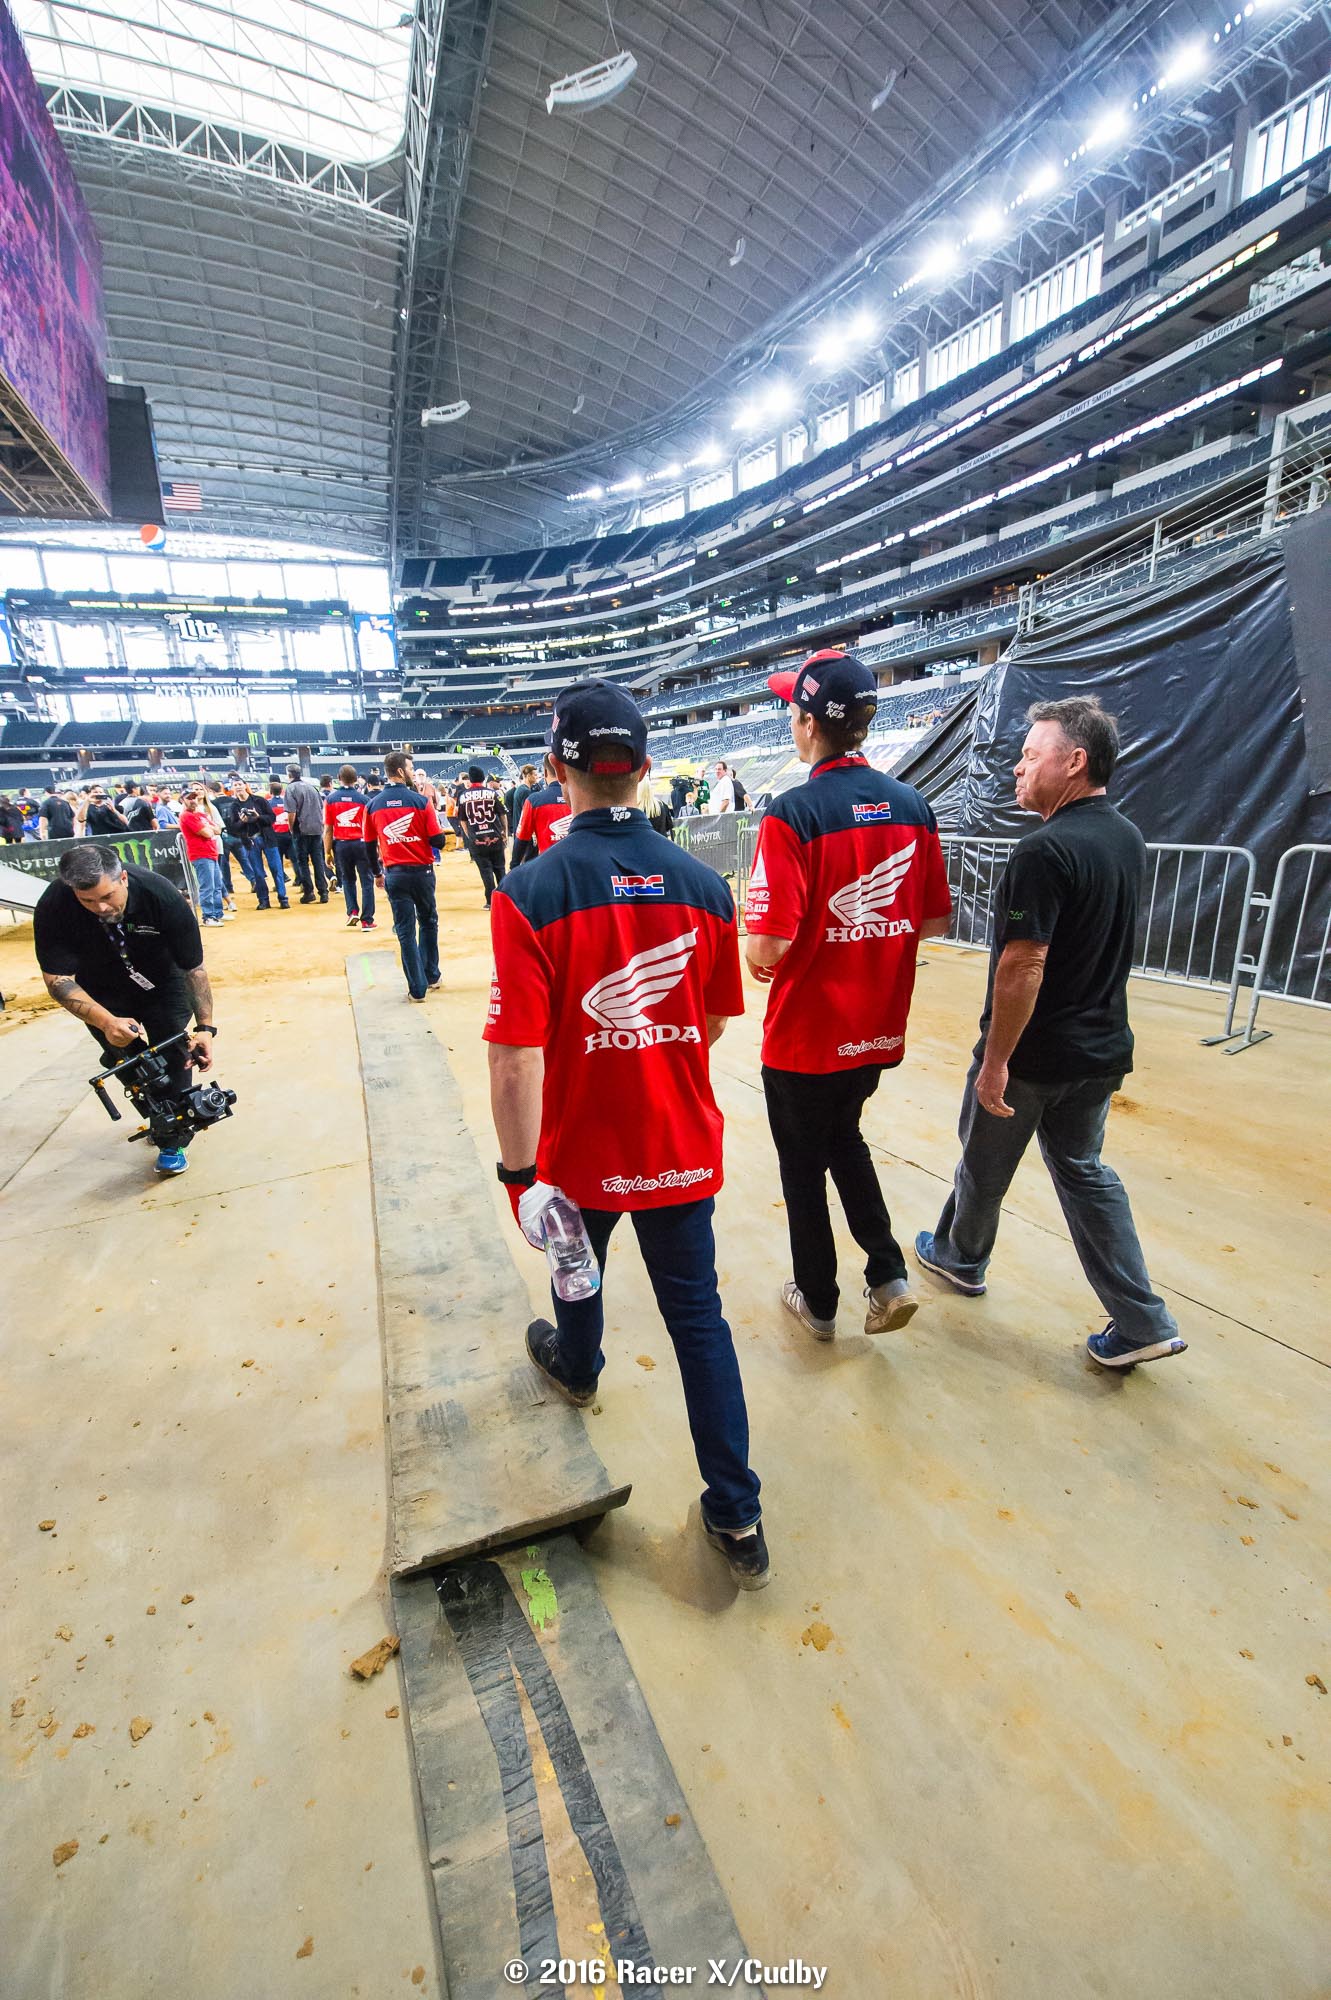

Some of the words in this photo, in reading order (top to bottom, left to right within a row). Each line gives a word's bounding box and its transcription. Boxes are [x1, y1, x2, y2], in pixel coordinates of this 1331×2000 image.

[1193, 338, 1205, 350] 73
[1206, 322, 1236, 344] LARRY
[1236, 304, 1266, 327] ALLEN
[1091, 388, 1112, 406] SMITH
[155, 684, 188, 698] AT&T
[190, 684, 249, 698] STADIUM
[825, 700, 845, 711] RIDE
[825, 707, 845, 719] RED
[561, 738, 579, 749] RIDE
[562, 747, 580, 760] RED
[612, 811, 631, 822] RED
[386, 835, 422, 845] HONDA
[825, 918, 915, 943] HONDA
[584, 1023, 701, 1055] HONDA
[602, 1175, 633, 1195] Troy
[631, 1175, 658, 1191] Lee
[659, 1168, 713, 1188] Designs
